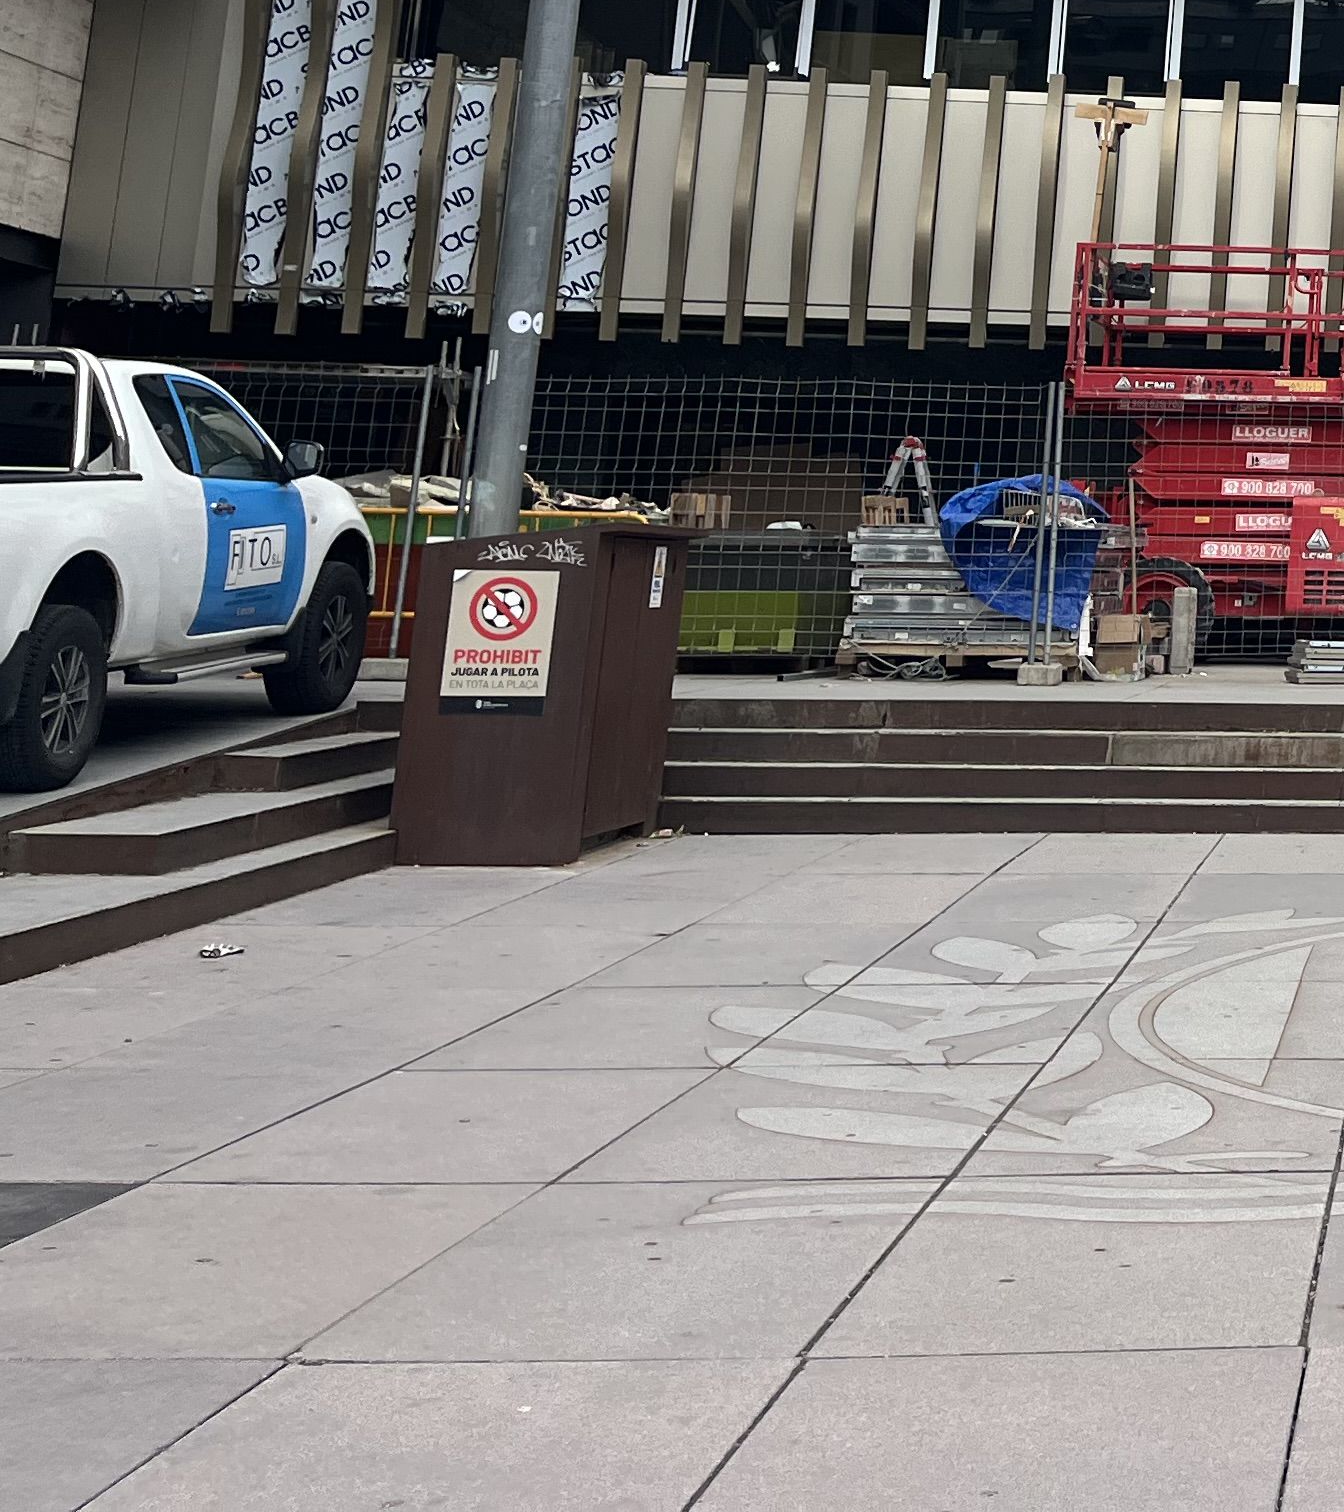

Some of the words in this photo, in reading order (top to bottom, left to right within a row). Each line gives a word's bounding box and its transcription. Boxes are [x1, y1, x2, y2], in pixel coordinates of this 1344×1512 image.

[1235, 427, 1309, 438] LLOGUER
[1242, 482, 1262, 494] 900
[1238, 516, 1292, 527] LLOGU
[231, 537, 272, 571] FITO
[1220, 545, 1241, 557] 900
[453, 649, 542, 664] PROHIBIT
[451, 668, 488, 677] JUGAR
[490, 668, 498, 676] A
[500, 668, 540, 676] PILOTA
[449, 680, 463, 689] EN
[466, 680, 489, 689] TOTA
[491, 680, 504, 689] LA
[506, 680, 539, 690] PLAÇA
